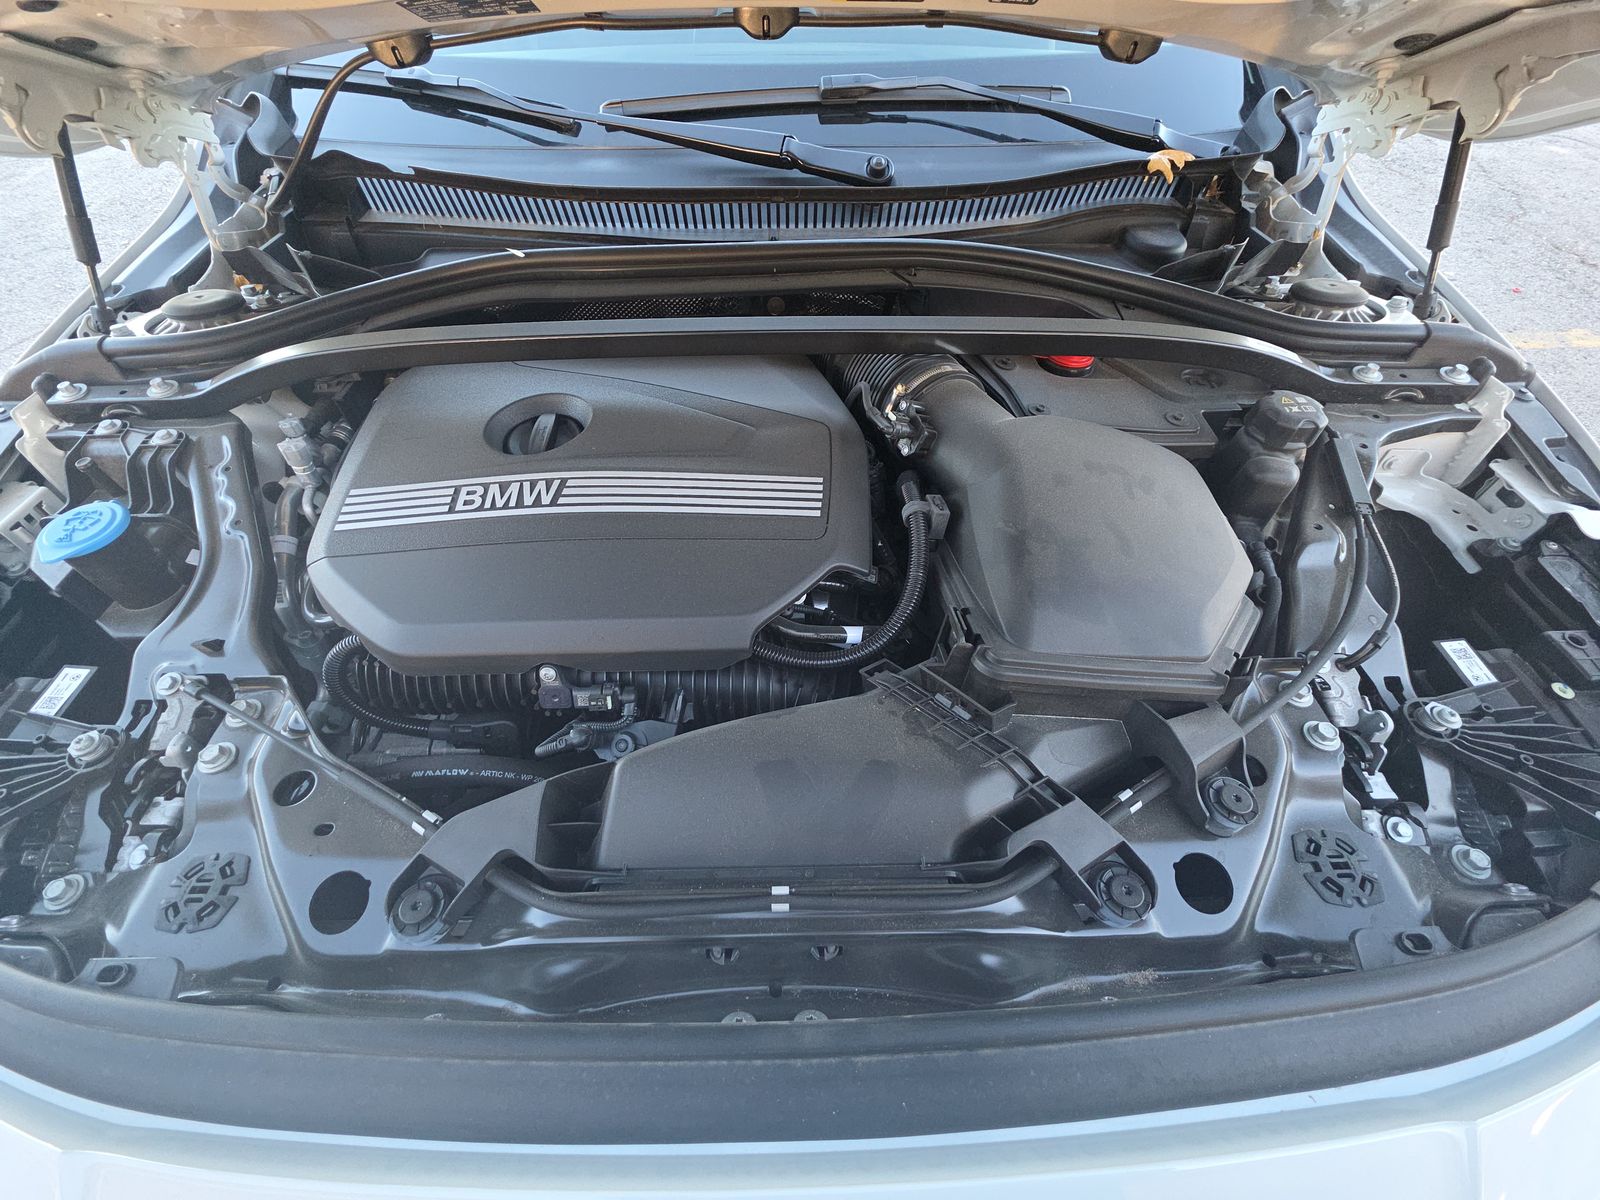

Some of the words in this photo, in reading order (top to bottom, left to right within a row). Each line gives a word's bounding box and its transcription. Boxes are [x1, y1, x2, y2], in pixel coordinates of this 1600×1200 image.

[455, 480, 561, 511] BMW
[425, 768, 469, 776] MAFLOW
[480, 769, 503, 778] ARTIC
[521, 774, 533, 782] WP
